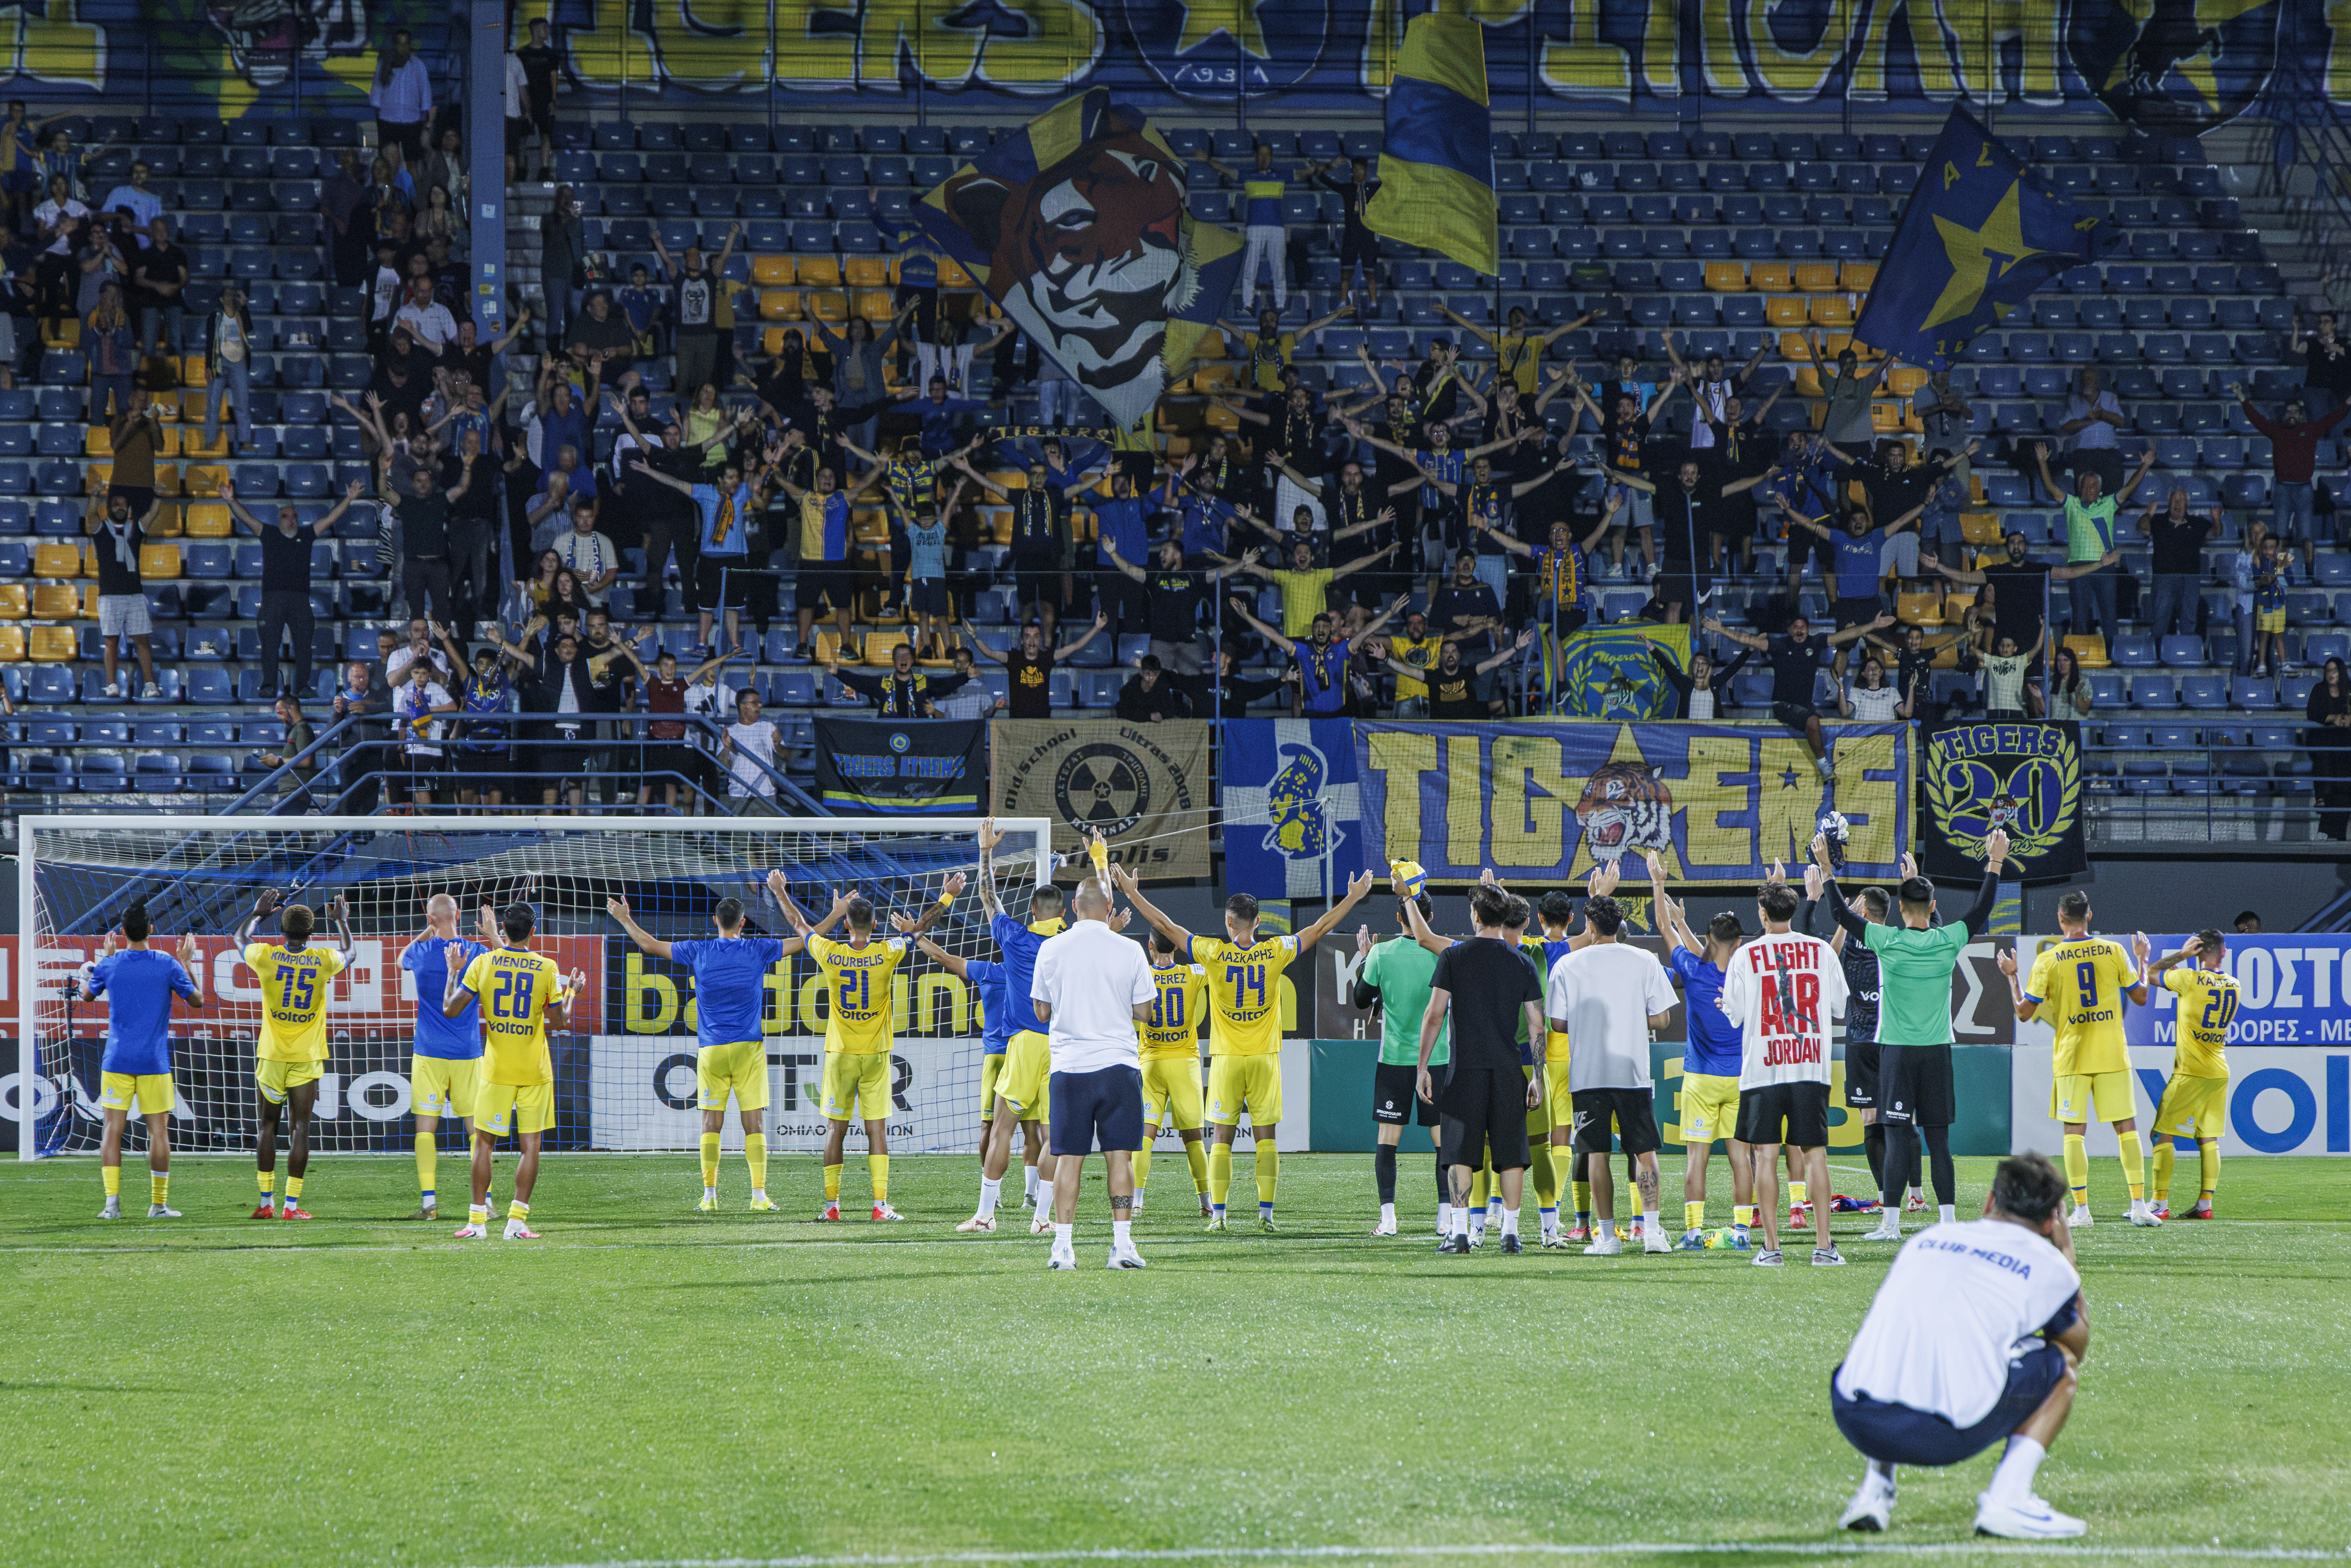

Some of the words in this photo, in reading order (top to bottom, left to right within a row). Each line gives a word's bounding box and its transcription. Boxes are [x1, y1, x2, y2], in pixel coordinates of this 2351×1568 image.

[1932, 724, 2063, 761] TIGERS
[1368, 732, 1897, 867] TIGERS
[1942, 757, 2064, 840] 20
[270, 951, 321, 967] KIMPIOKA
[491, 955, 543, 971] MENDEZ
[827, 953, 884, 967] KOURBELIS
[1217, 948, 1274, 963] ΛΑΣΚΑΡΗΣ
[1748, 942, 1821, 974] FLIGHT
[2055, 945, 2112, 962] MACHEDA
[275, 965, 317, 1009] 75
[493, 971, 534, 1019] 28
[839, 969, 869, 1010] 21
[1154, 973, 1187, 985] PEREZ
[1226, 964, 1265, 1008] 74
[2077, 962, 2098, 1007] 9
[2068, 1010, 2113, 1025] volton
[2202, 989, 2237, 1029] 20
[487, 1021, 534, 1036] volton
[1764, 1038, 1821, 1066] JORDAN
[777, 1125, 827, 1136] ΟΜΙΛΟ
[1917, 1238, 1966, 1254] CLUB
[1971, 1247, 2032, 1280] MEDIA
